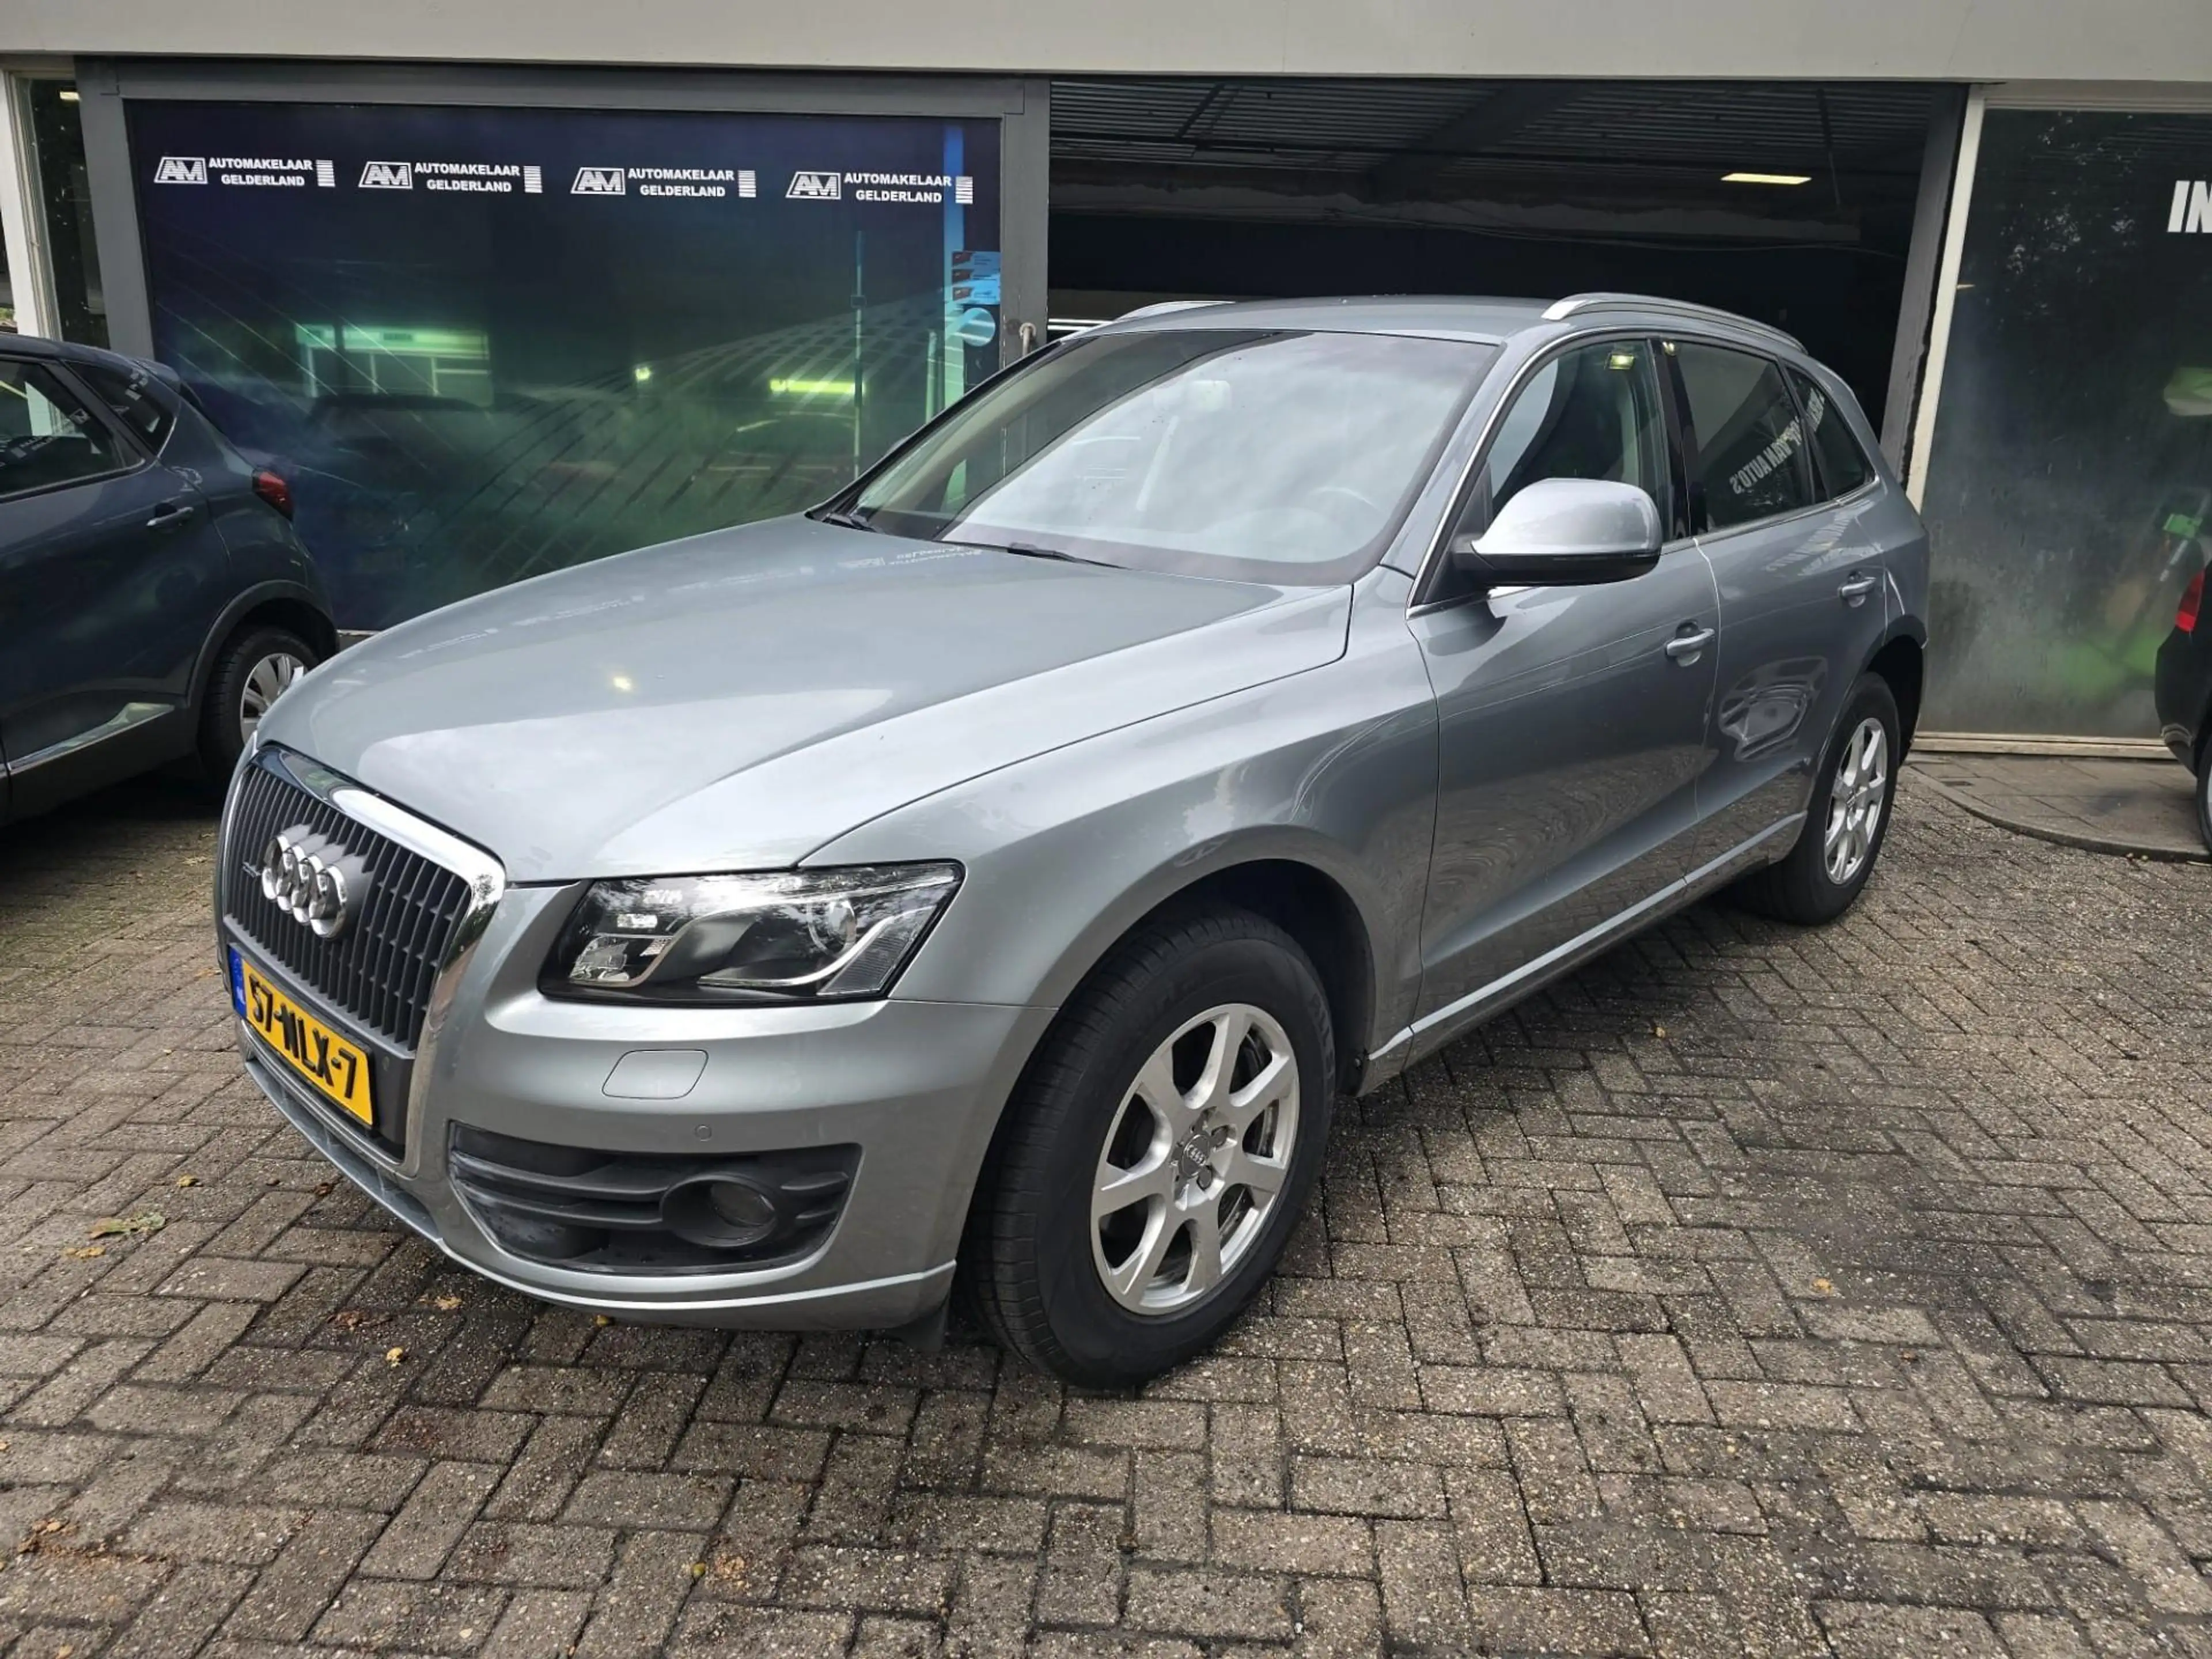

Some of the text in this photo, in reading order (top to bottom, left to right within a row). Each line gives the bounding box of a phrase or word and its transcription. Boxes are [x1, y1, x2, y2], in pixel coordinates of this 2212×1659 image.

[209, 157, 313, 171] AUTOMAKELAAR
[414, 162, 521, 176] AUTOMAKELAAR
[221, 174, 305, 187] GELDERLAND
[627, 168, 735, 181] AUTOMAKELAAR
[843, 172, 953, 187] AUTOMAKELAAR
[426, 179, 513, 192] GELDERLAND
[639, 184, 726, 198] GELDERLAND
[855, 190, 943, 203] GELDERLAND
[248, 973, 358, 1100] 57-NLX-7
